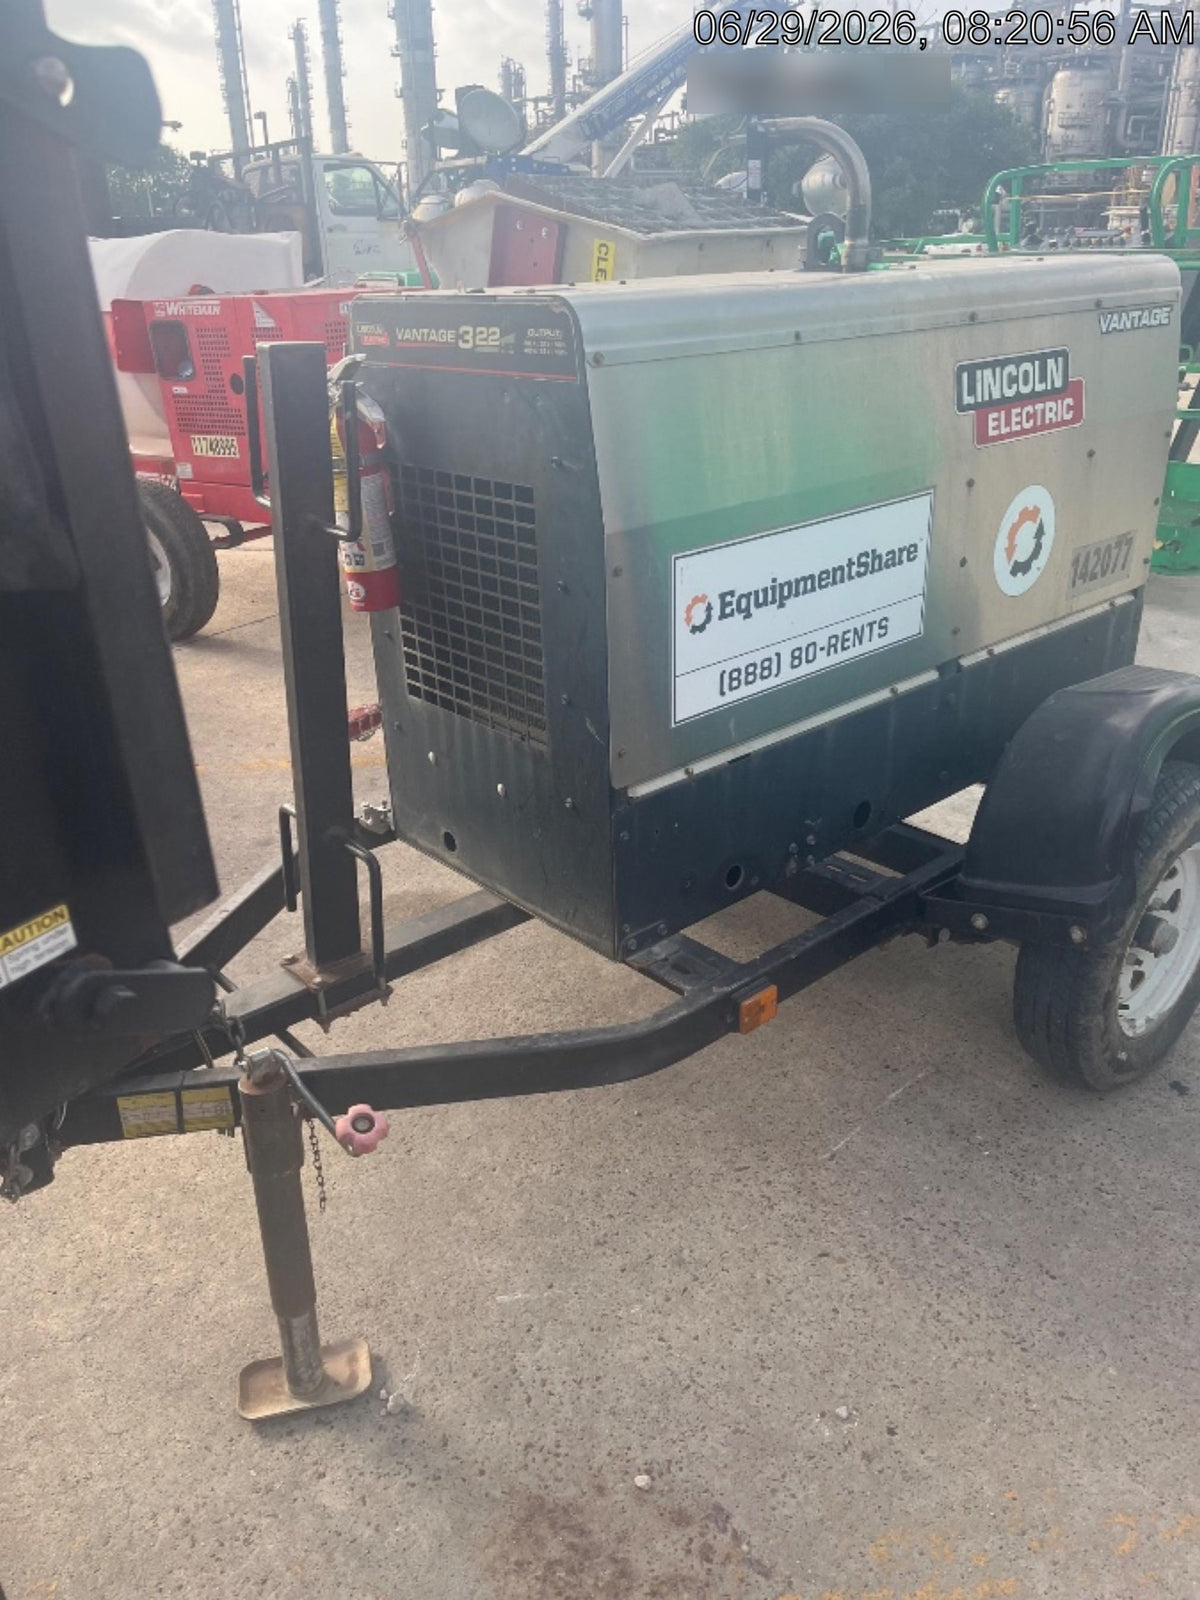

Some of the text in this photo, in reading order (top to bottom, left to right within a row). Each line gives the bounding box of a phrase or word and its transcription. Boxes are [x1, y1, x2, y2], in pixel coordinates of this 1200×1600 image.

[396, 327, 456, 343] VANTAGE
[458, 326, 500, 350] 322
[1100, 307, 1171, 334] VANTAGE
[961, 357, 1064, 405] LINCOLN
[988, 397, 1074, 436] ELECTRIC
[717, 542, 919, 621] EquipmentShare
[1071, 534, 1134, 588] 142077
[719, 616, 889, 696] (888) 80-RENTS
[0, 908, 65, 951] AUTION
